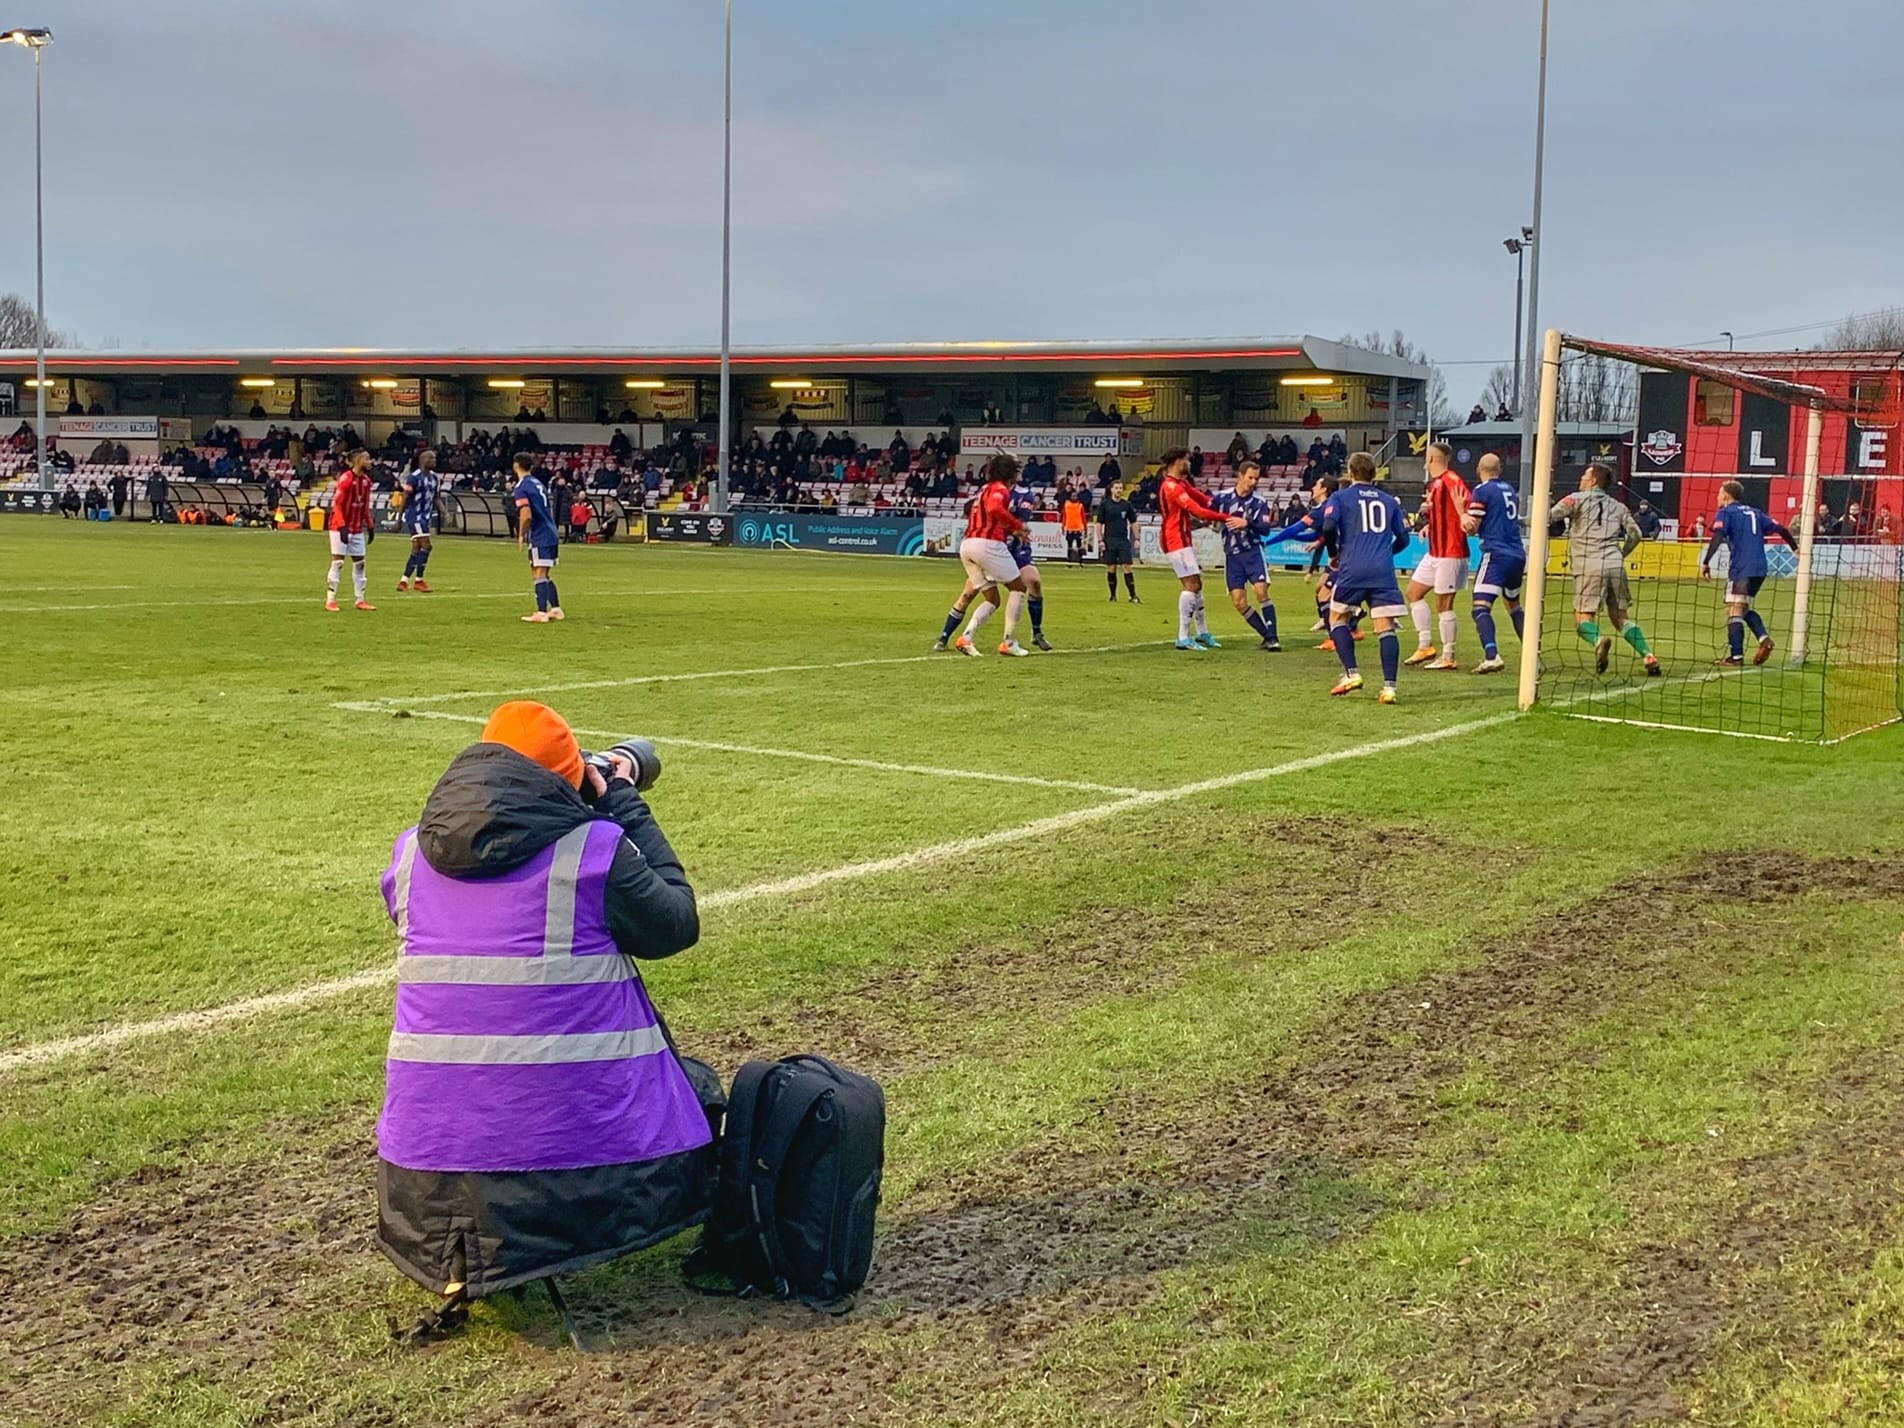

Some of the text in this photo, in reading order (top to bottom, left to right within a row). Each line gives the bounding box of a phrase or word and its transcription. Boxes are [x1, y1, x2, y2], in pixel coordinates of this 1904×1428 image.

[130, 422, 156, 433] TRUST
[963, 436, 1116, 448] TEENAGE CANCER TRUST
[1750, 431, 1888, 467] L E
[1358, 499, 1386, 533] 10
[1502, 491, 1517, 519] 5
[1598, 501, 1604, 526] 1
[761, 523, 800, 544] ASL
[808, 525, 826, 533] Public
[1742, 510, 1757, 535] 7
